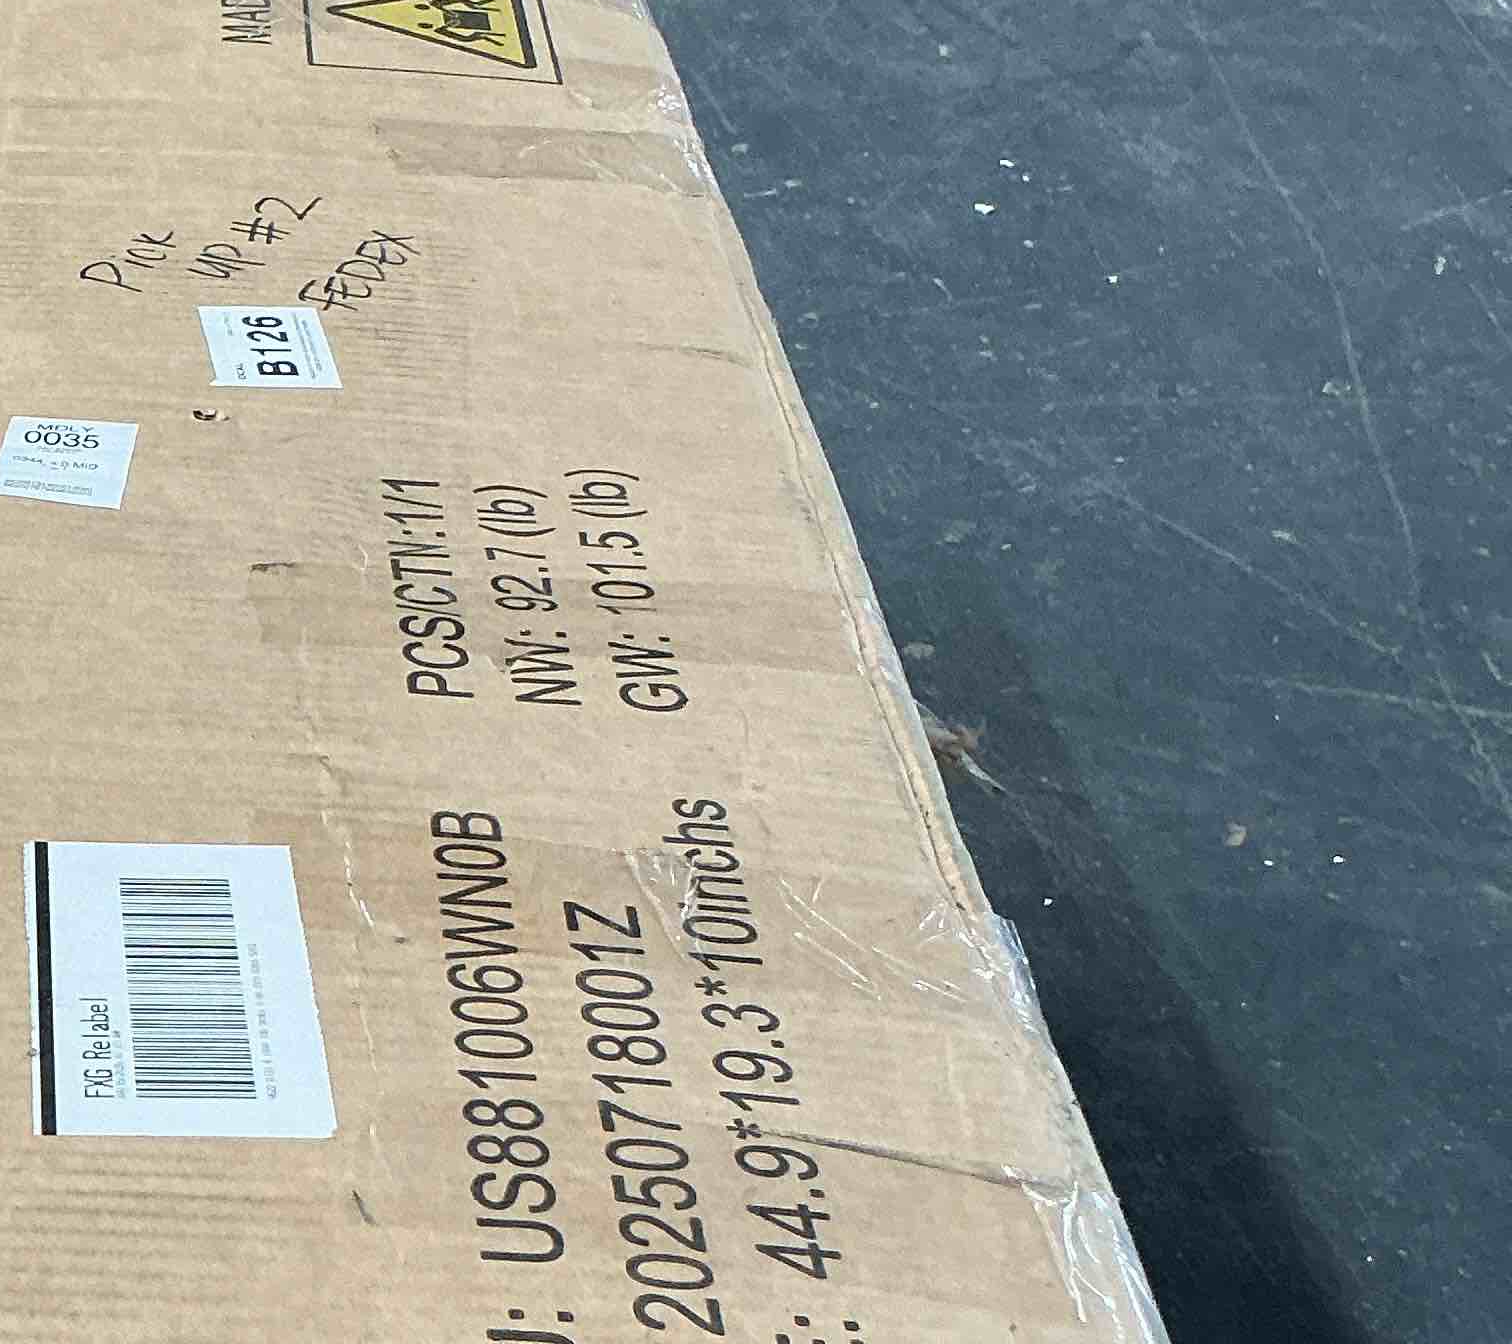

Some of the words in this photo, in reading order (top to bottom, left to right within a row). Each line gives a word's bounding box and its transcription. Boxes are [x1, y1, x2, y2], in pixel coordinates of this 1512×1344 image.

[242, 315, 300, 377] B126
[23, 429, 101, 450] 0035
[473, 483, 549, 538] (lb)
[564, 467, 642, 522] (lb)
[381, 476, 475, 699] PCS/CTN:1/1
[490, 550, 556, 615] 92.7
[591, 529, 656, 615] 101.5
[515, 626, 581, 708] NW:
[619, 632, 689, 714] GW:
[79, 997, 112, 1060] Relabel
[431, 809, 566, 1264] US881006WN0B
[83, 1068, 114, 1099] FXG
[565, 901, 724, 1336] 20250718001Z
